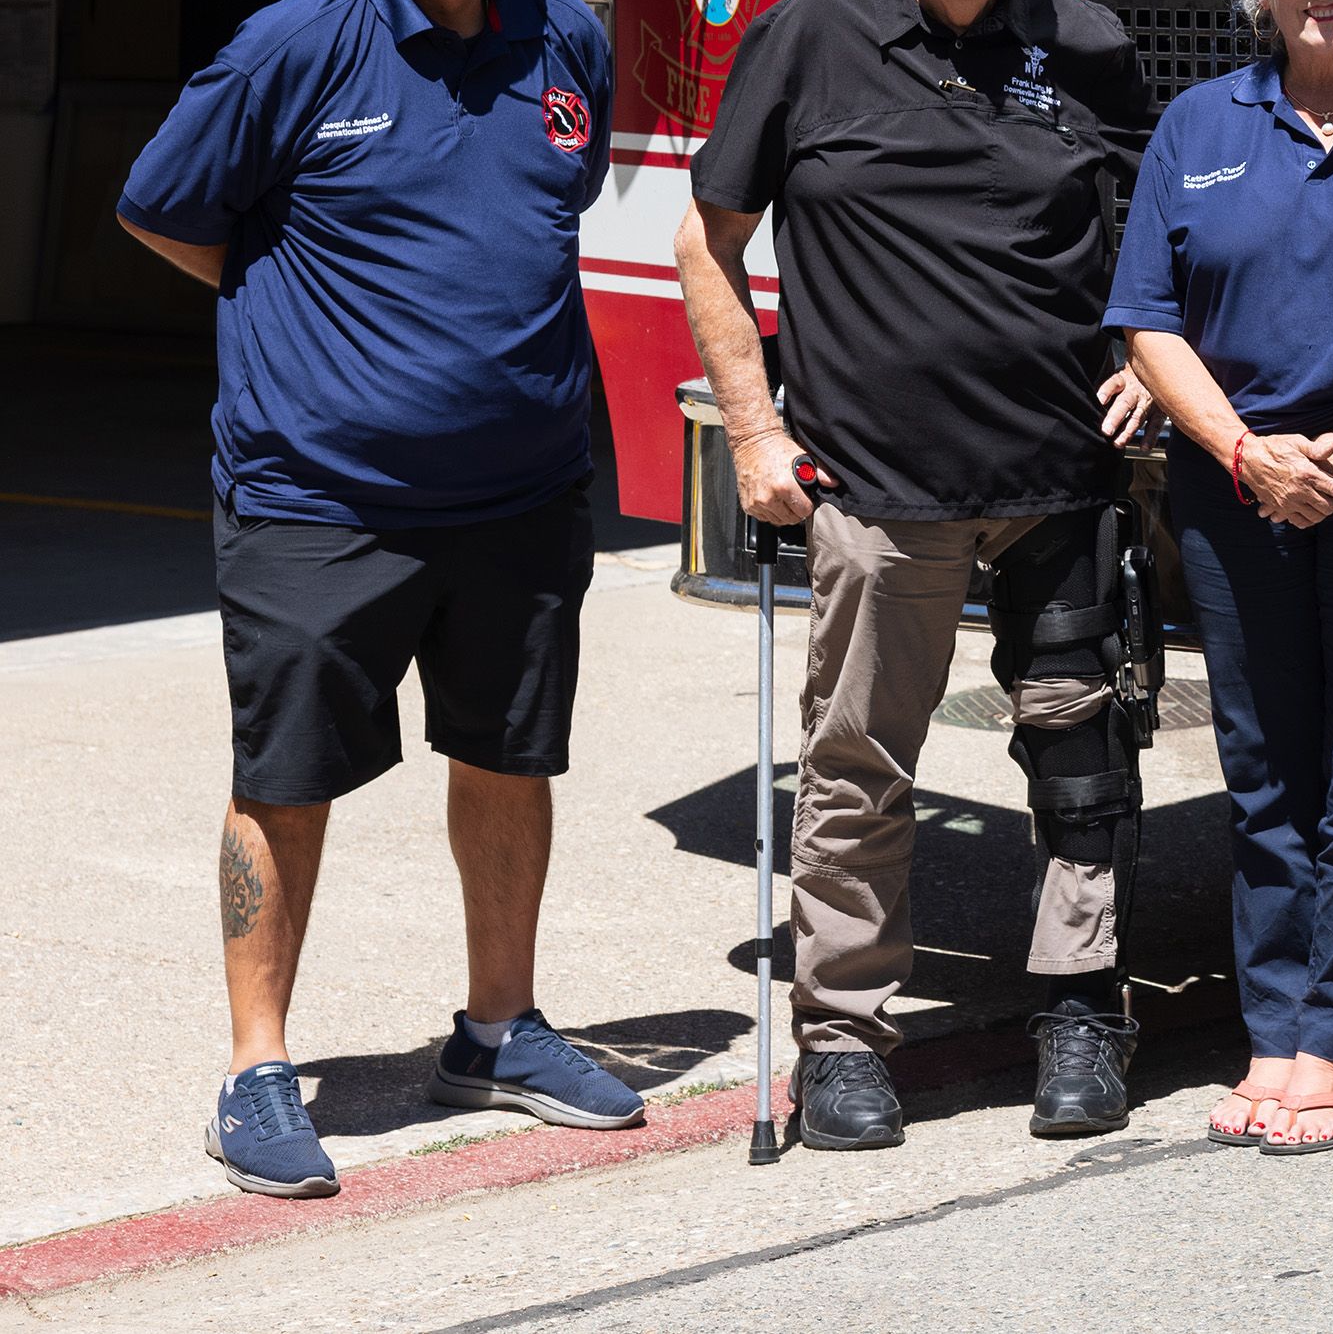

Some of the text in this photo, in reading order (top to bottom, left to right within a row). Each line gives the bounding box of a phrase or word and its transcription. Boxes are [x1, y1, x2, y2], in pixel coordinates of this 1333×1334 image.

[1011, 77, 1030, 88] Frank
[667, 65, 710, 123] FIRE
[317, 120, 393, 139] International Director
[1184, 169, 1221, 182] Katherine
[1183, 179, 1216, 189] Director
